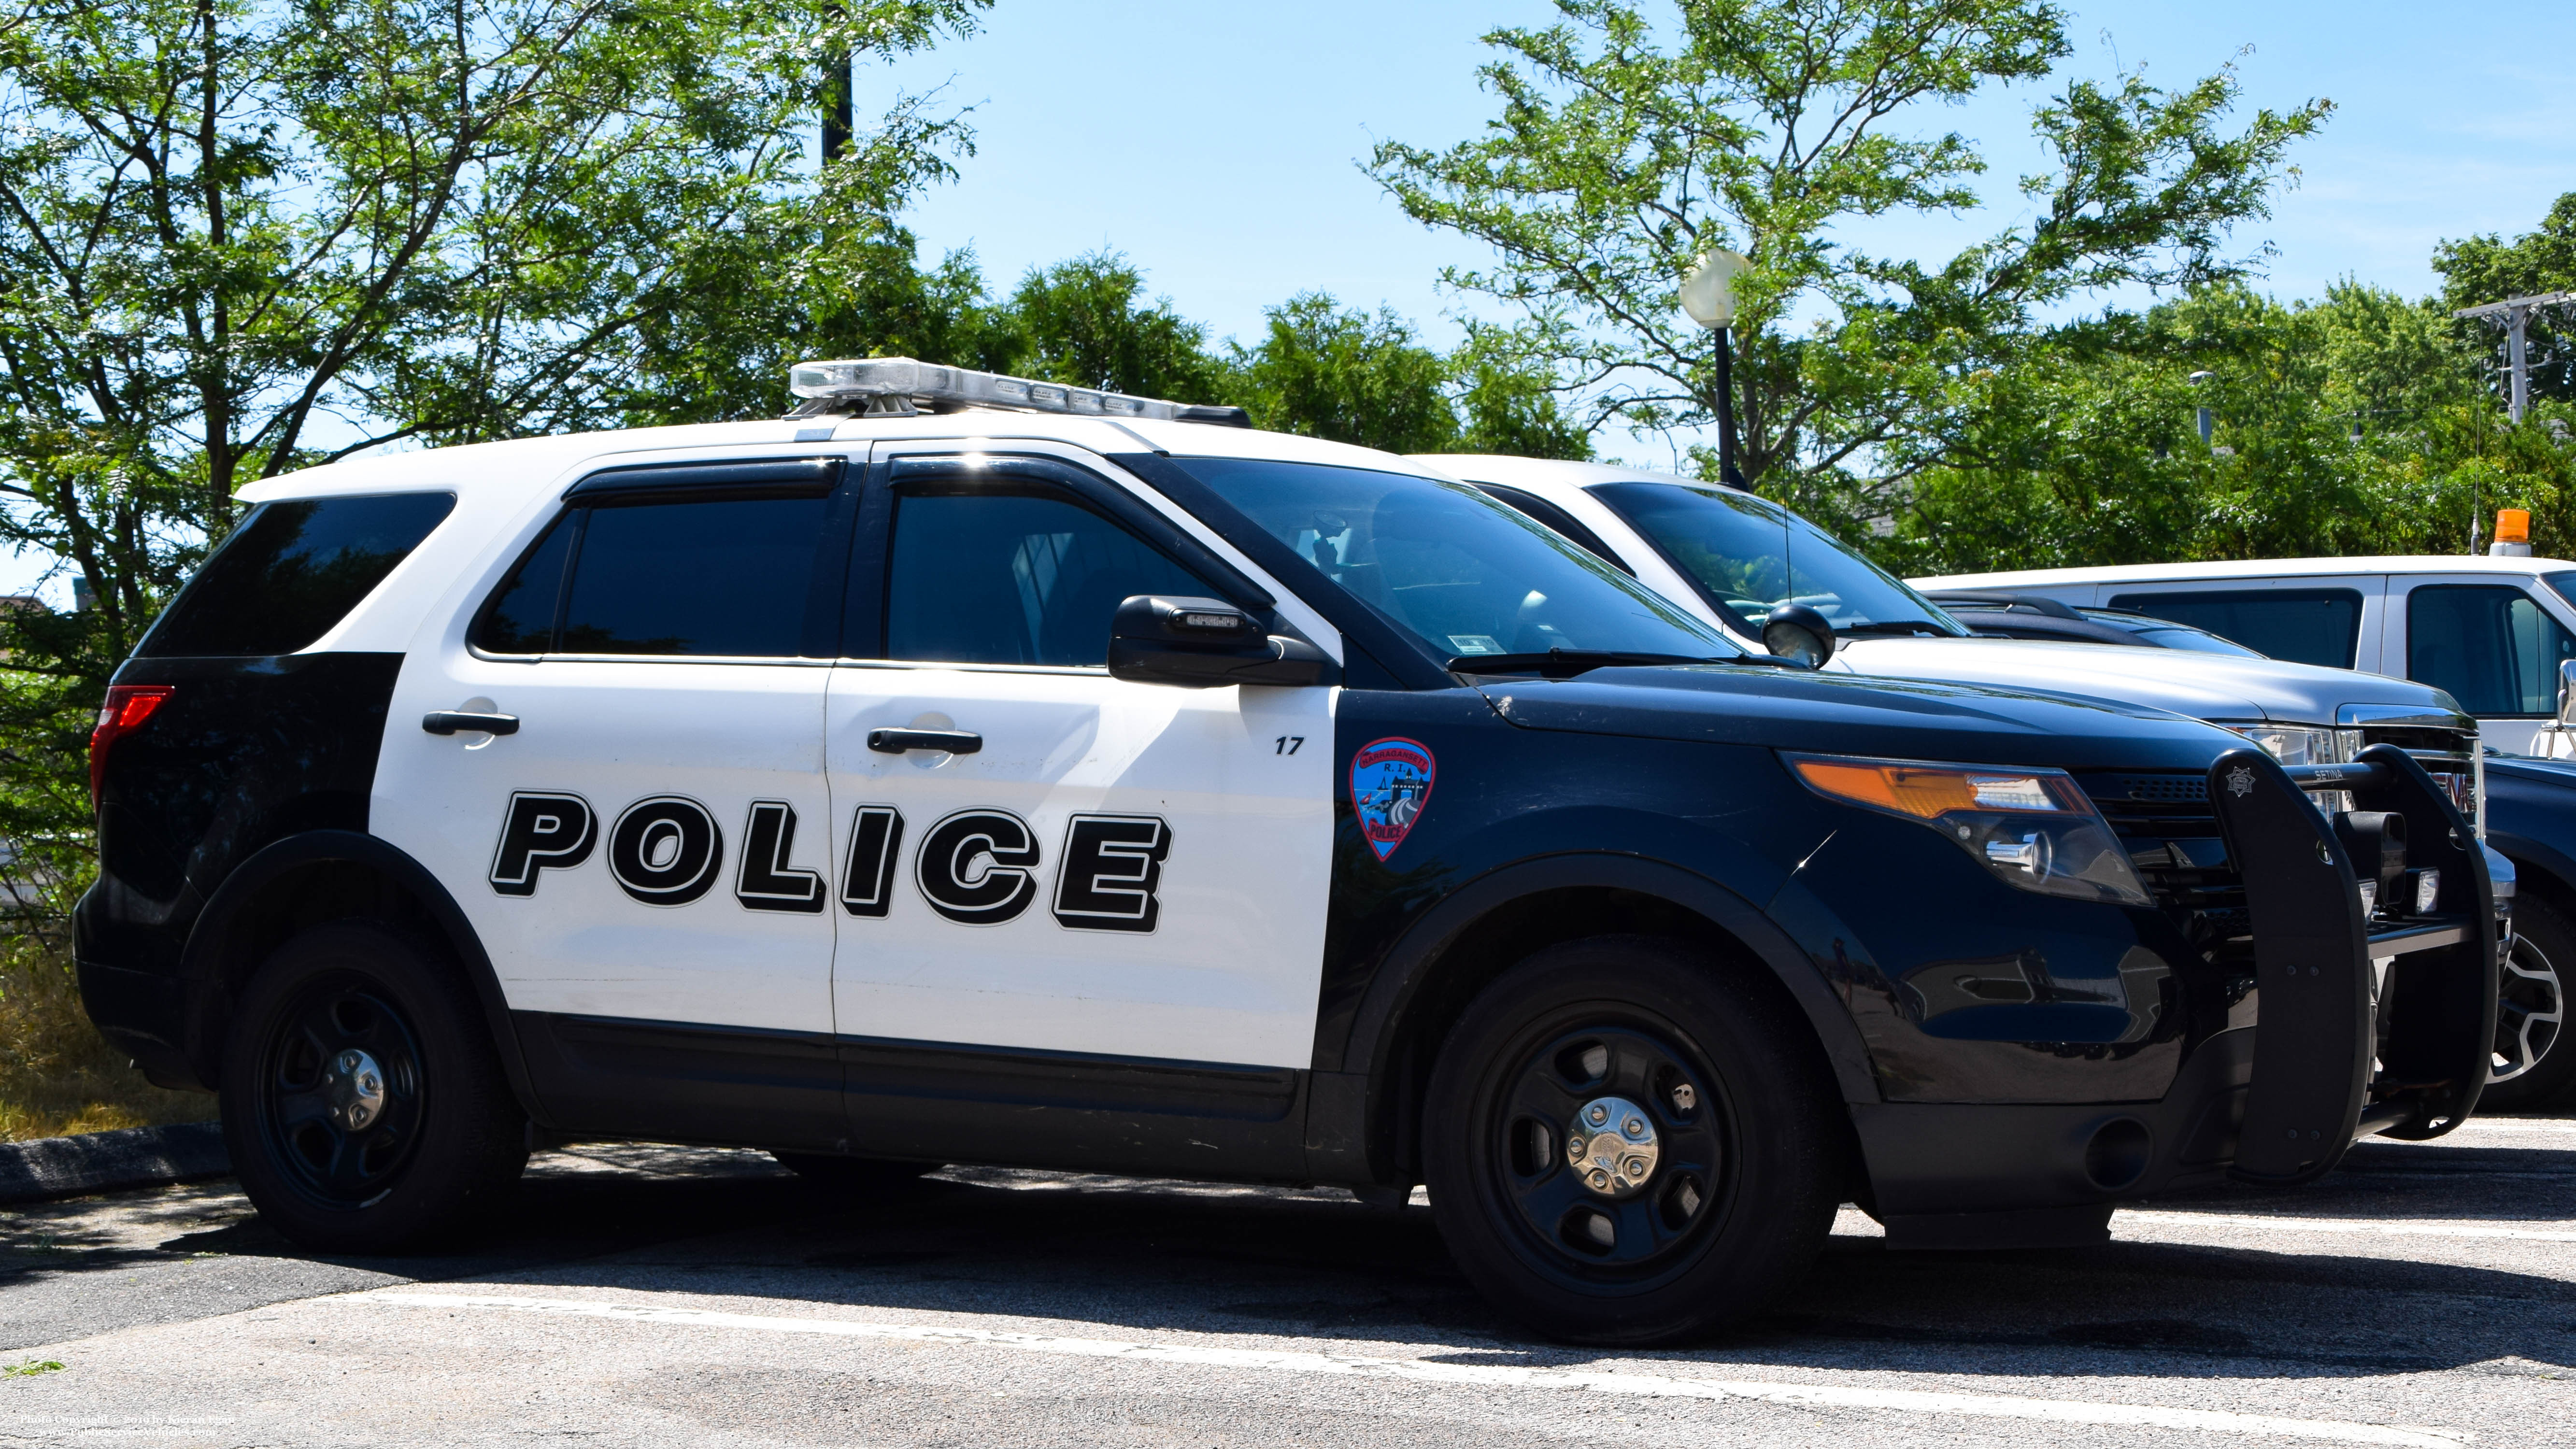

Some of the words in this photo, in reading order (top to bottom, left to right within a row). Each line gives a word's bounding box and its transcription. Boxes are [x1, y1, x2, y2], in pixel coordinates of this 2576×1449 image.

[1276, 736, 1305, 755] 17
[1362, 750, 1428, 767] NARRAGANSETT
[2314, 769, 2343, 781] SETINA
[1370, 825, 1402, 839] POLICE
[489, 789, 1174, 934] POLICE
